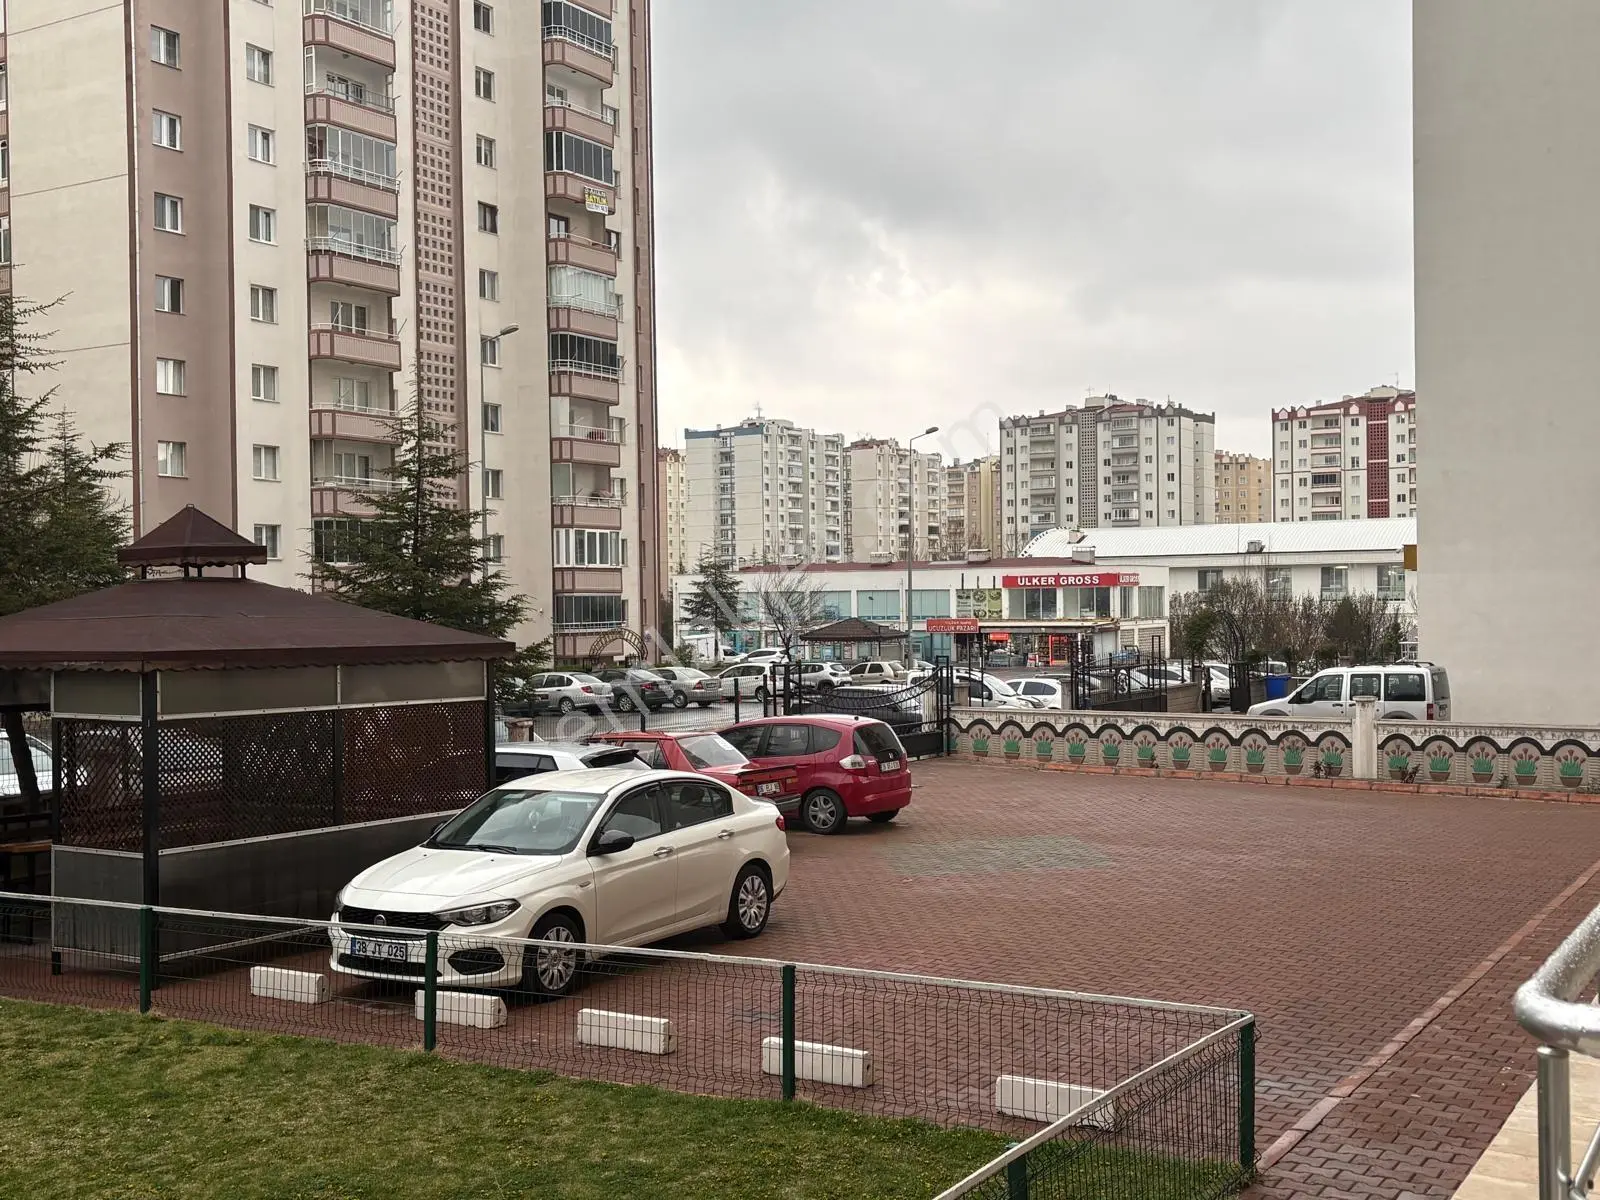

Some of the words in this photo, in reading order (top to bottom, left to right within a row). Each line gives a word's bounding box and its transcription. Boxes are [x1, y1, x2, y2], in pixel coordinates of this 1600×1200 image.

[1060, 575, 1100, 585] GROSS
[356, 941, 367, 954] 38
[371, 942, 382, 955] JT
[387, 944, 404, 958] 025
